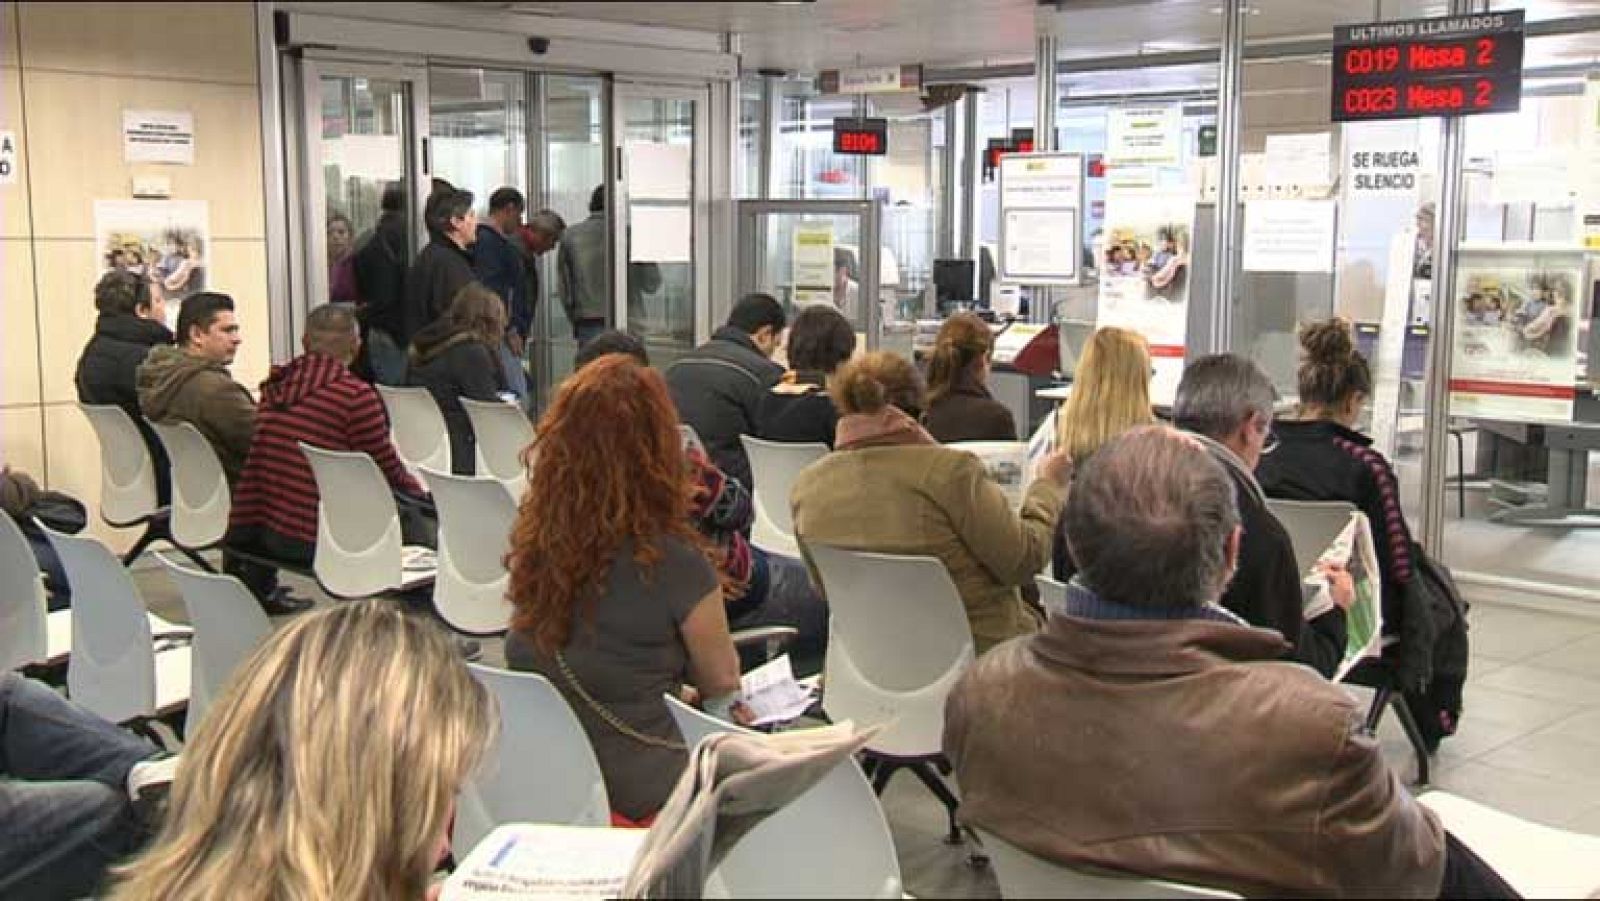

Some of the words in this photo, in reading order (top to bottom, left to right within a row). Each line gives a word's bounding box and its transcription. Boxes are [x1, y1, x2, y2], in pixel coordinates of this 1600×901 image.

[1418, 16, 1504, 35] LLAMADOS
[1409, 44, 1465, 70] Mesa
[1477, 38, 1494, 65] 2
[1408, 84, 1464, 110] Mesa
[1475, 80, 1493, 107] 2
[1352, 151, 1369, 169] SE
[1372, 150, 1419, 168] RUEGA
[1354, 173, 1415, 190] SILENCIO
